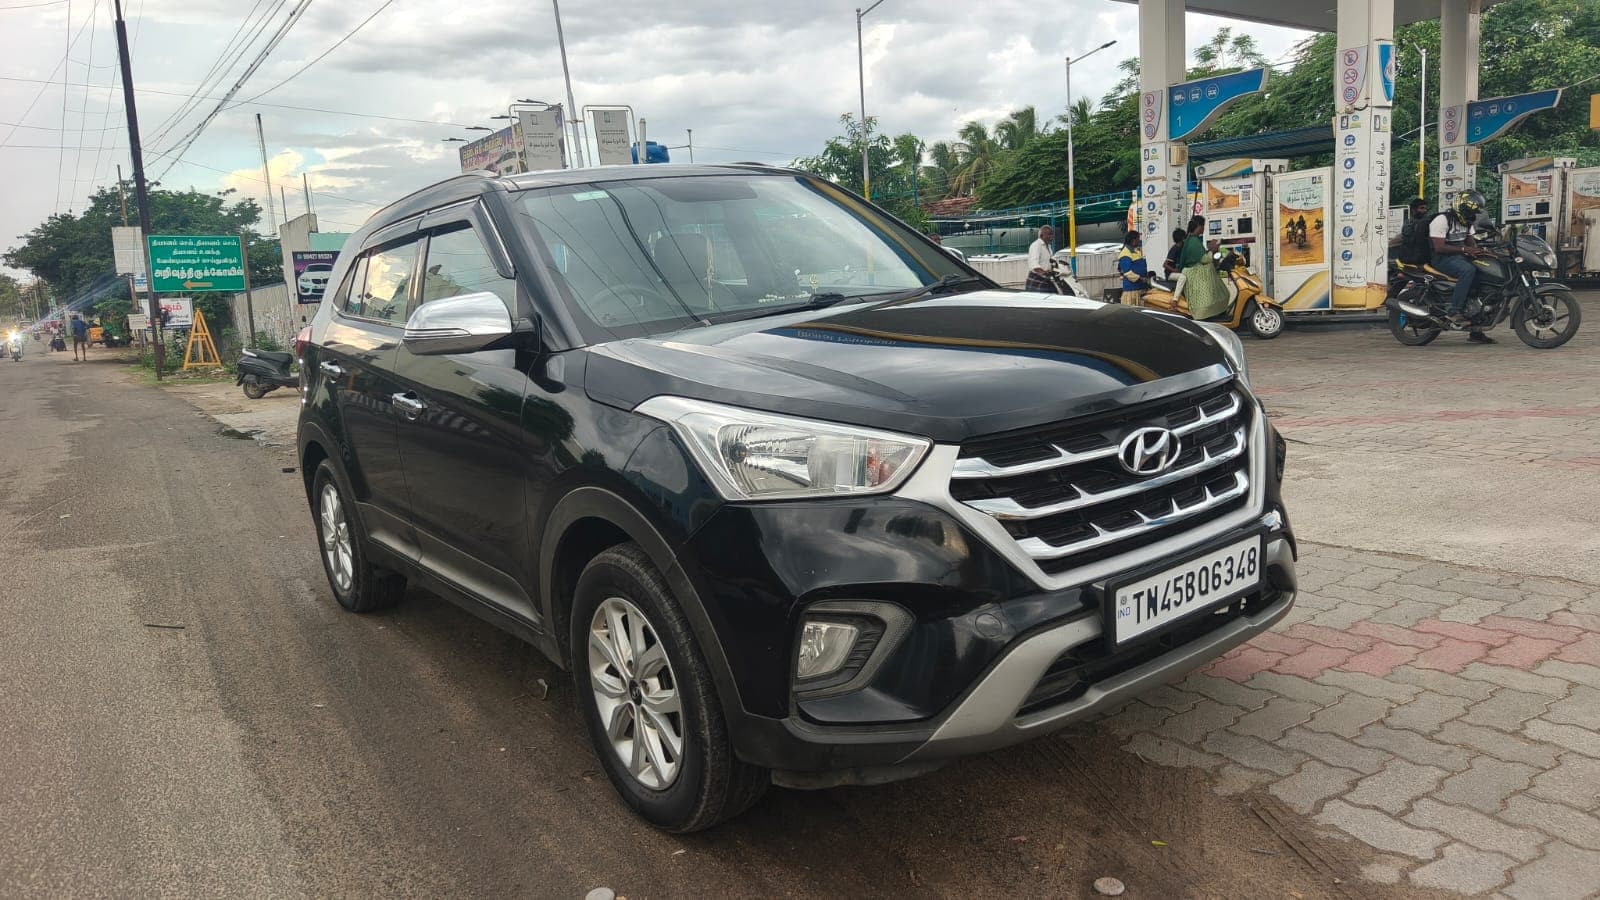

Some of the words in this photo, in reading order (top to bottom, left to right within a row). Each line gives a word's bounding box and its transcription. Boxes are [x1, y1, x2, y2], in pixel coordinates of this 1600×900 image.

[1176, 115, 1183, 127] 1
[1474, 126, 1482, 136] 3
[154, 266, 244, 280] அறிவுத்திருக்கோயில்
[1118, 606, 1131, 620] IND
[1133, 546, 1257, 624] TN45BQ6348
